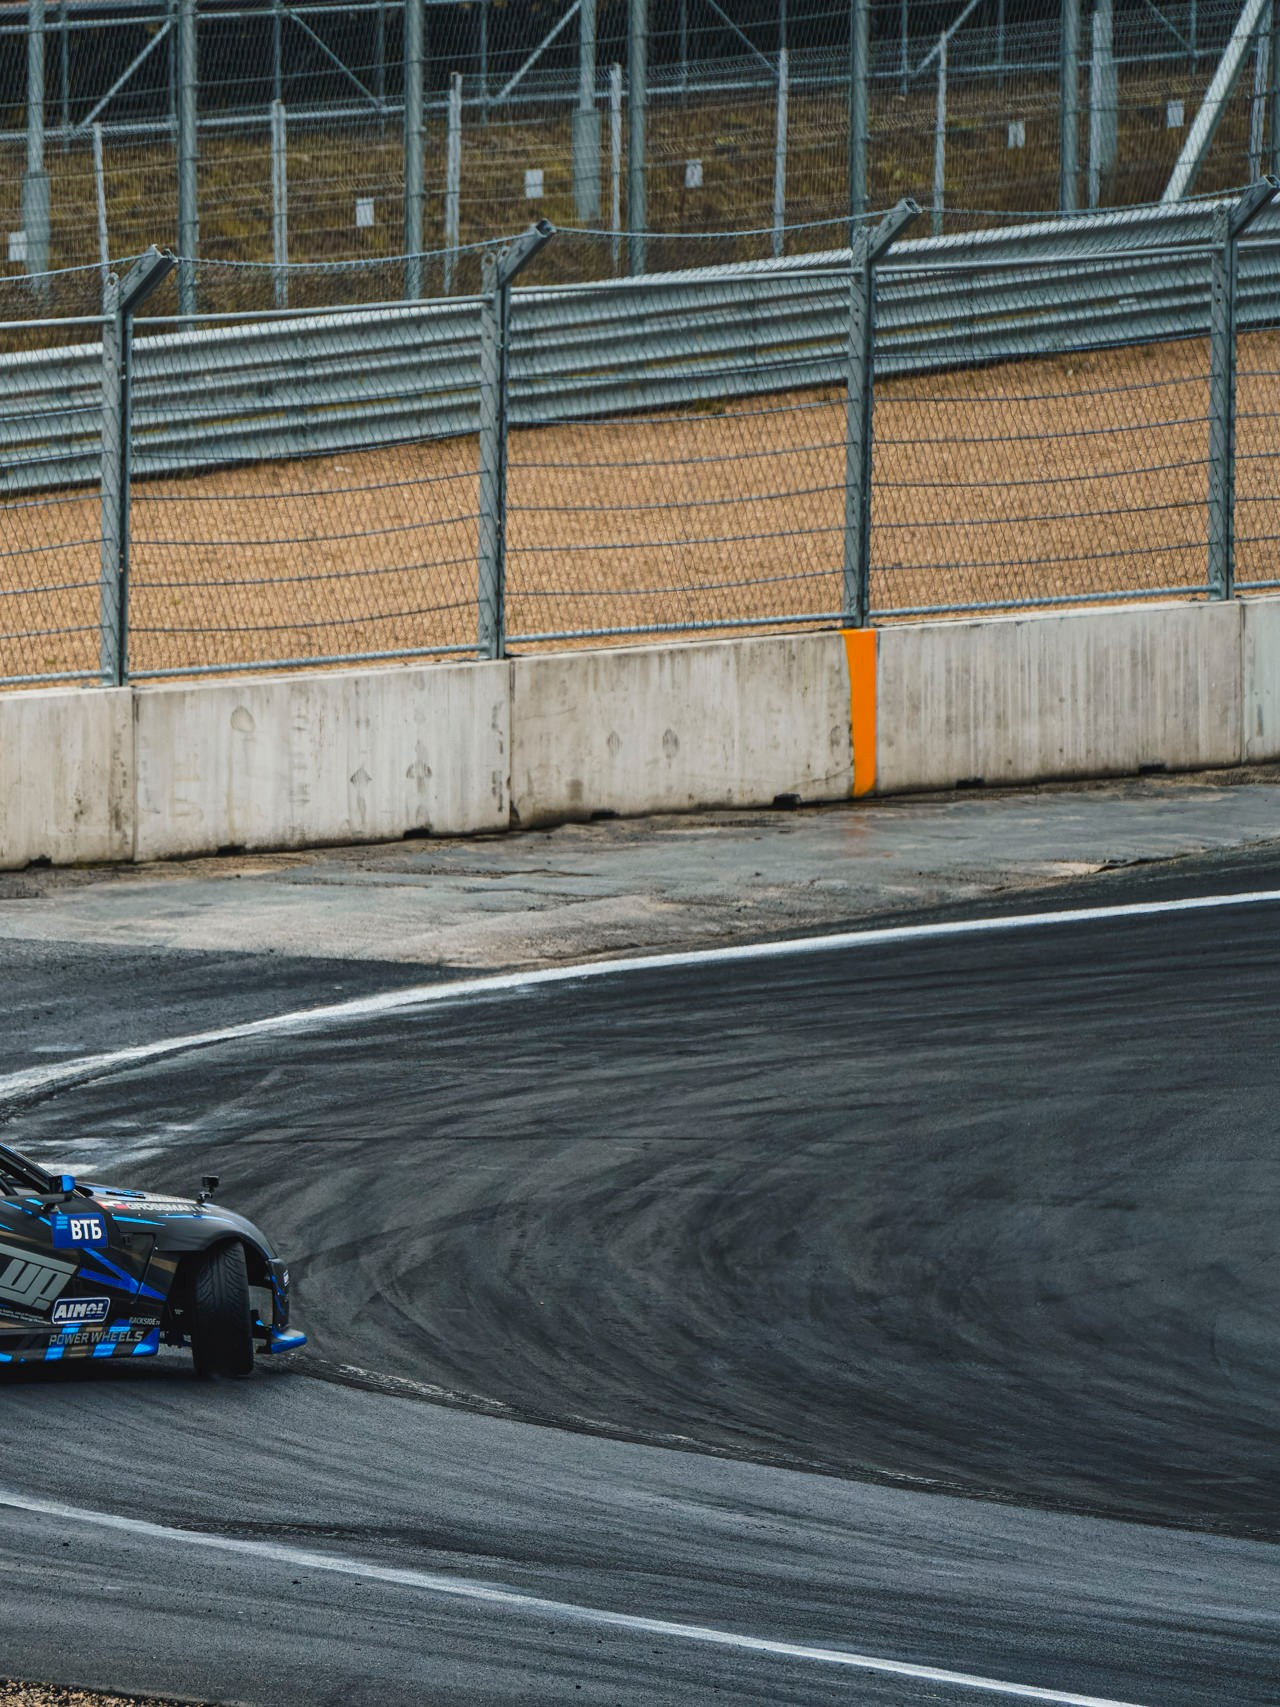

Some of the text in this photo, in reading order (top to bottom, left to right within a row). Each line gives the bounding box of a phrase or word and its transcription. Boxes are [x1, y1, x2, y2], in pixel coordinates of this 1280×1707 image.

[70, 1219, 103, 1240] ВТБ
[49, 1330, 144, 1345] POWER WHEELS
